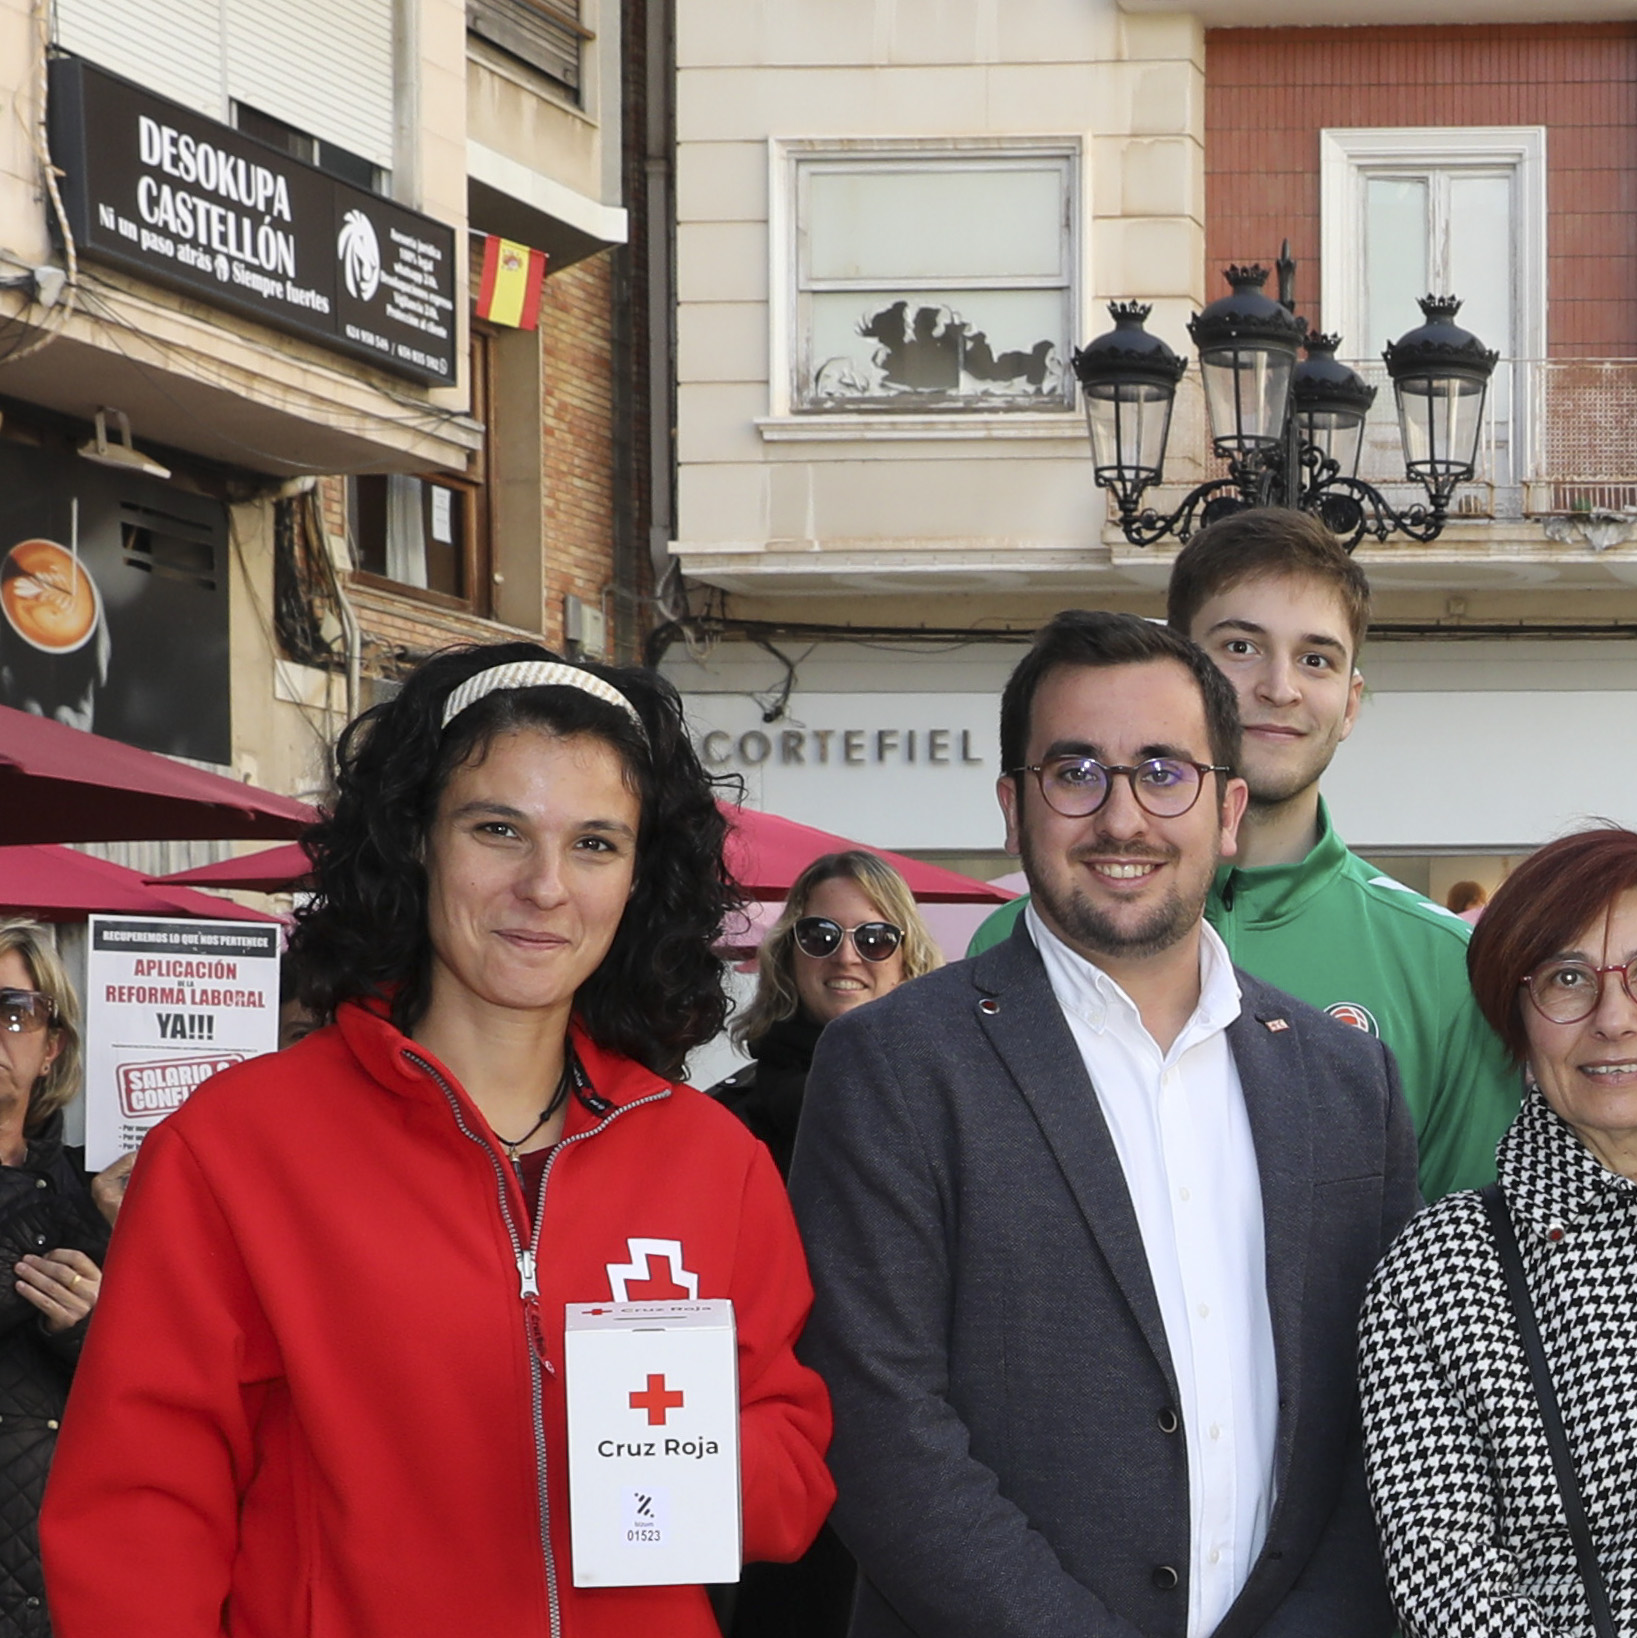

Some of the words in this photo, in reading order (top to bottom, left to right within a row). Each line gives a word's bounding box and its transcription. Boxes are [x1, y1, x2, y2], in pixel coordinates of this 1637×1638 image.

[138, 114, 292, 222] DESOKUPA
[136, 175, 296, 279] CASTELLÓN
[98, 203, 115, 231] Ni
[117, 215, 138, 243] un
[140, 228, 174, 258] paso
[177, 244, 213, 273] atrás
[232, 260, 284, 298] Siempre
[286, 280, 331, 314] fuertes
[702, 729, 983, 765] CORTEFIEL
[103, 930, 168, 943] RECUPEREMOS
[169, 933, 180, 944] LO
[181, 933, 199, 946] QUE
[200, 934, 219, 946] NOS
[220, 935, 269, 948] PERTENECE
[134, 959, 238, 980] APLICACIÓN
[105, 985, 187, 1005] REFORMA
[190, 988, 266, 1008] LABORAL
[156, 1012, 215, 1040] YA!!!
[128, 1063, 214, 1090] SALARIO
[597, 1438, 656, 1458] Cruz
[664, 1436, 720, 1460] Roja
[626, 1529, 661, 1543] 01523
